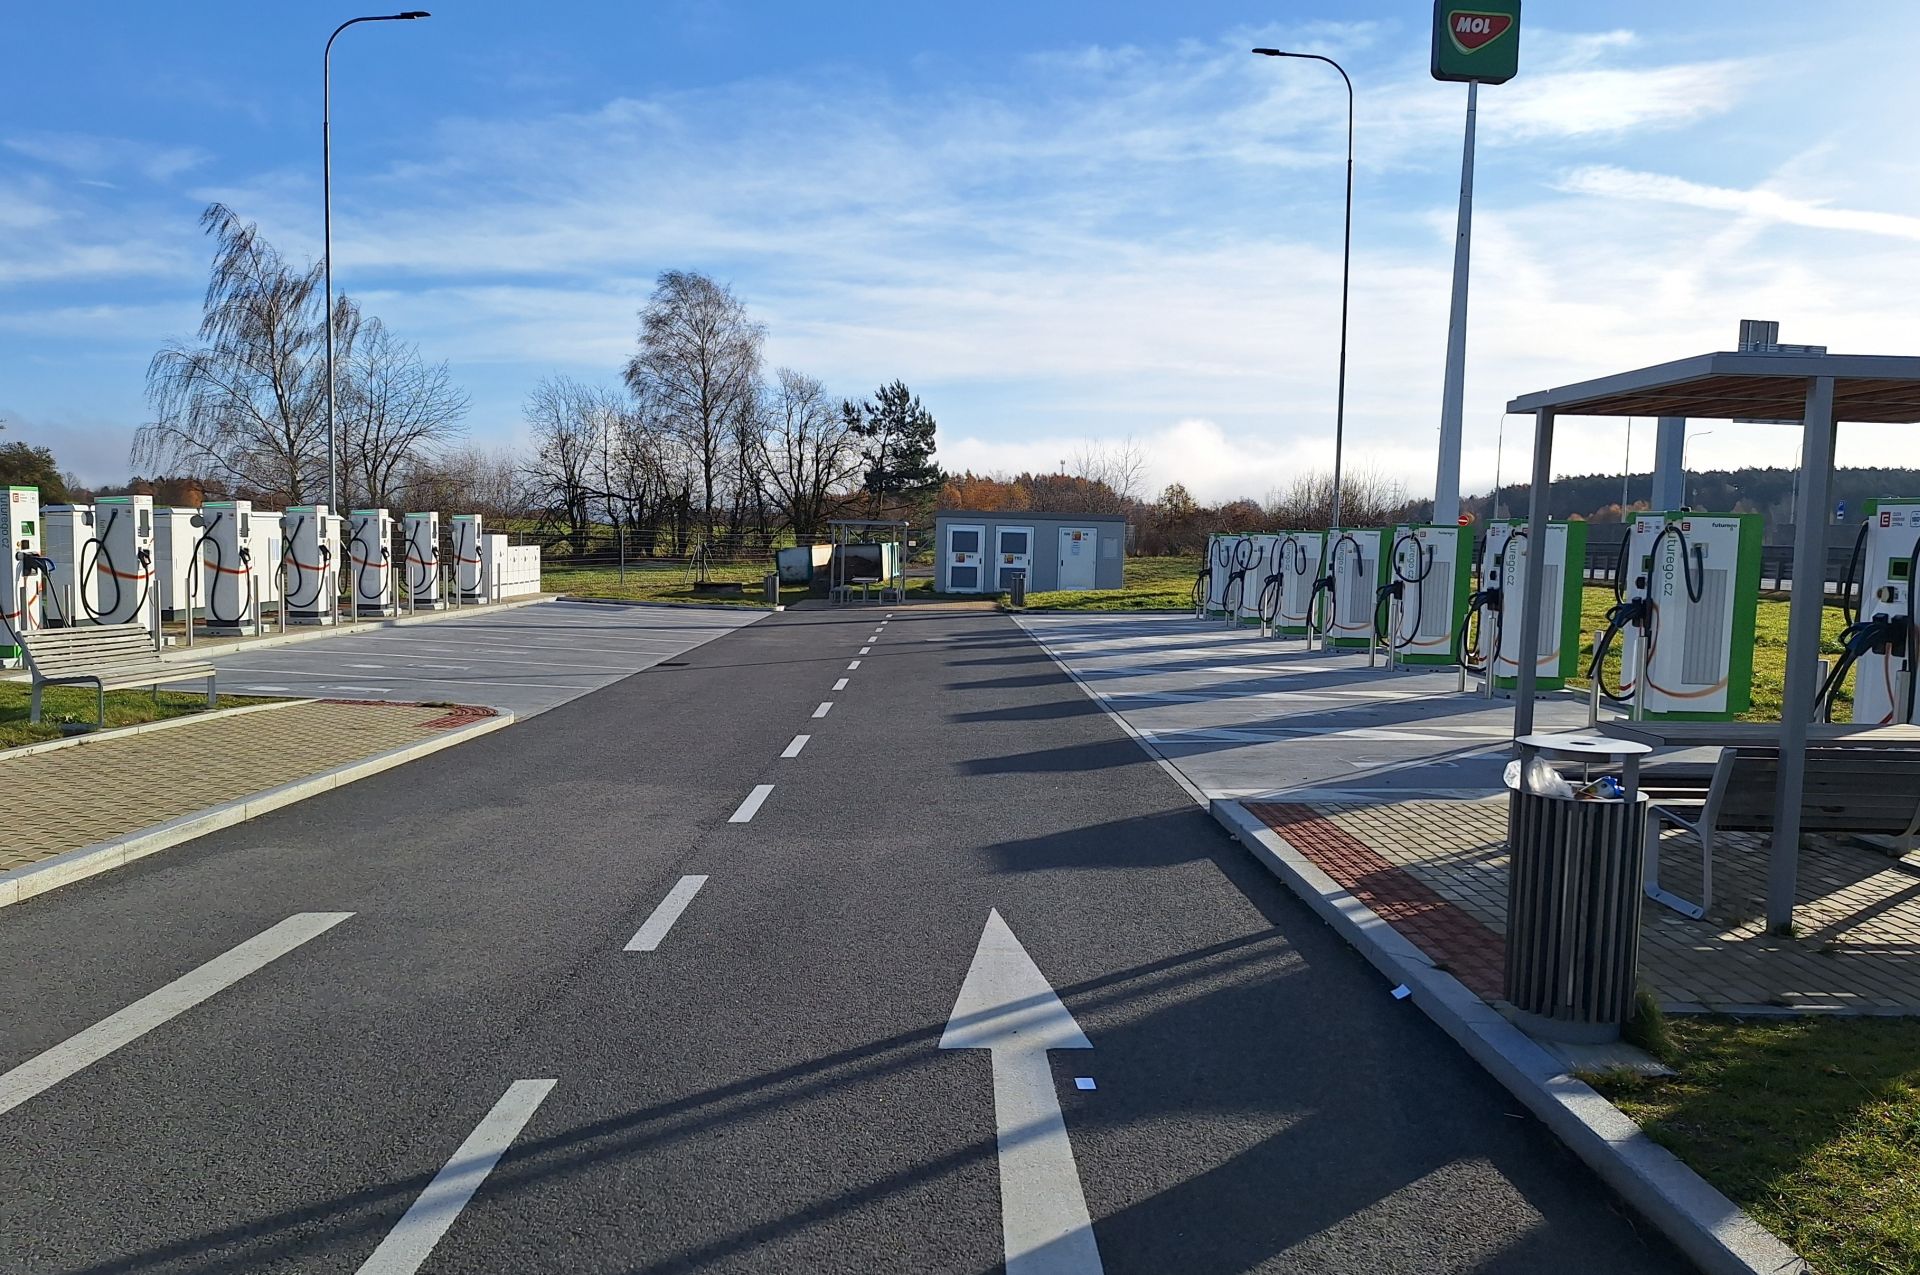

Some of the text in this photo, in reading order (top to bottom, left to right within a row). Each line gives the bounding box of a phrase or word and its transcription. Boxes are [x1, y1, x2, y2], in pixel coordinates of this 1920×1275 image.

[1455, 16, 1491, 34] MOL
[1406, 541, 1417, 579] turego.cz
[1505, 540, 1519, 586] turego.cz
[1662, 531, 1678, 597] uturego.cz
